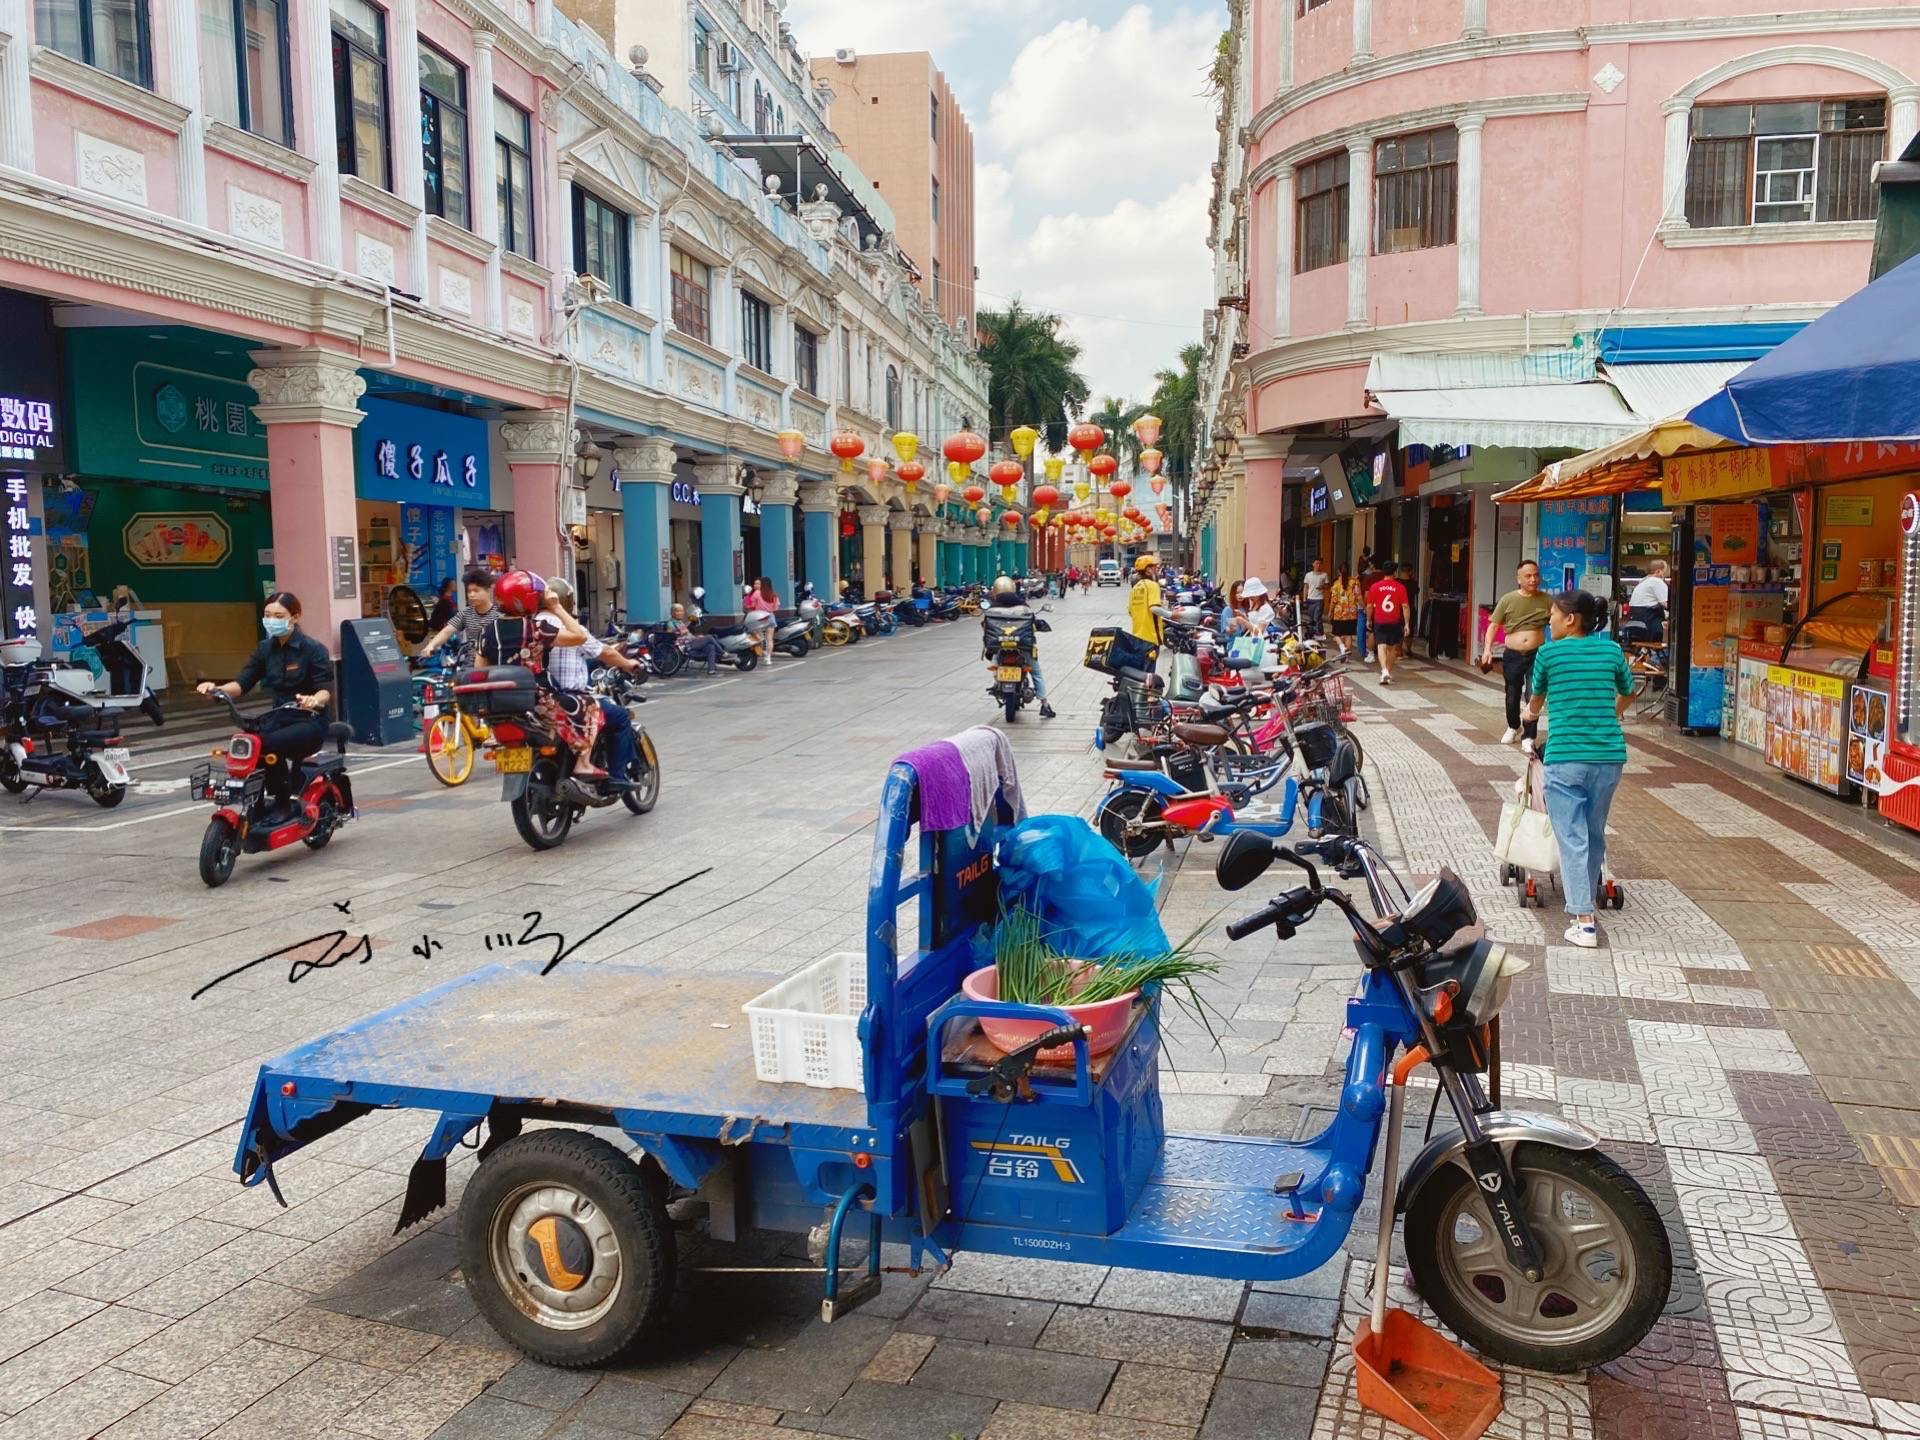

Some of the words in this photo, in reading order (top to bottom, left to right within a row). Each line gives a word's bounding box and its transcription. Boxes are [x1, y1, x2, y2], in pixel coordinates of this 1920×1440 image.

[0, 397, 53, 432] 数码
[194, 396, 268, 438] 桃園
[0, 430, 54, 448] DIGITAL
[379, 439, 477, 487] 傻子瓜子
[6, 478, 33, 586] 手机批发
[1381, 594, 1395, 613] 6
[955, 853, 989, 889] TAILG
[1009, 1134, 1071, 1149] TAILG
[989, 1157, 1040, 1179] 台铃
[1496, 1198, 1523, 1248] TAILG
[1012, 1236, 1072, 1251] TL1500DZH-3
